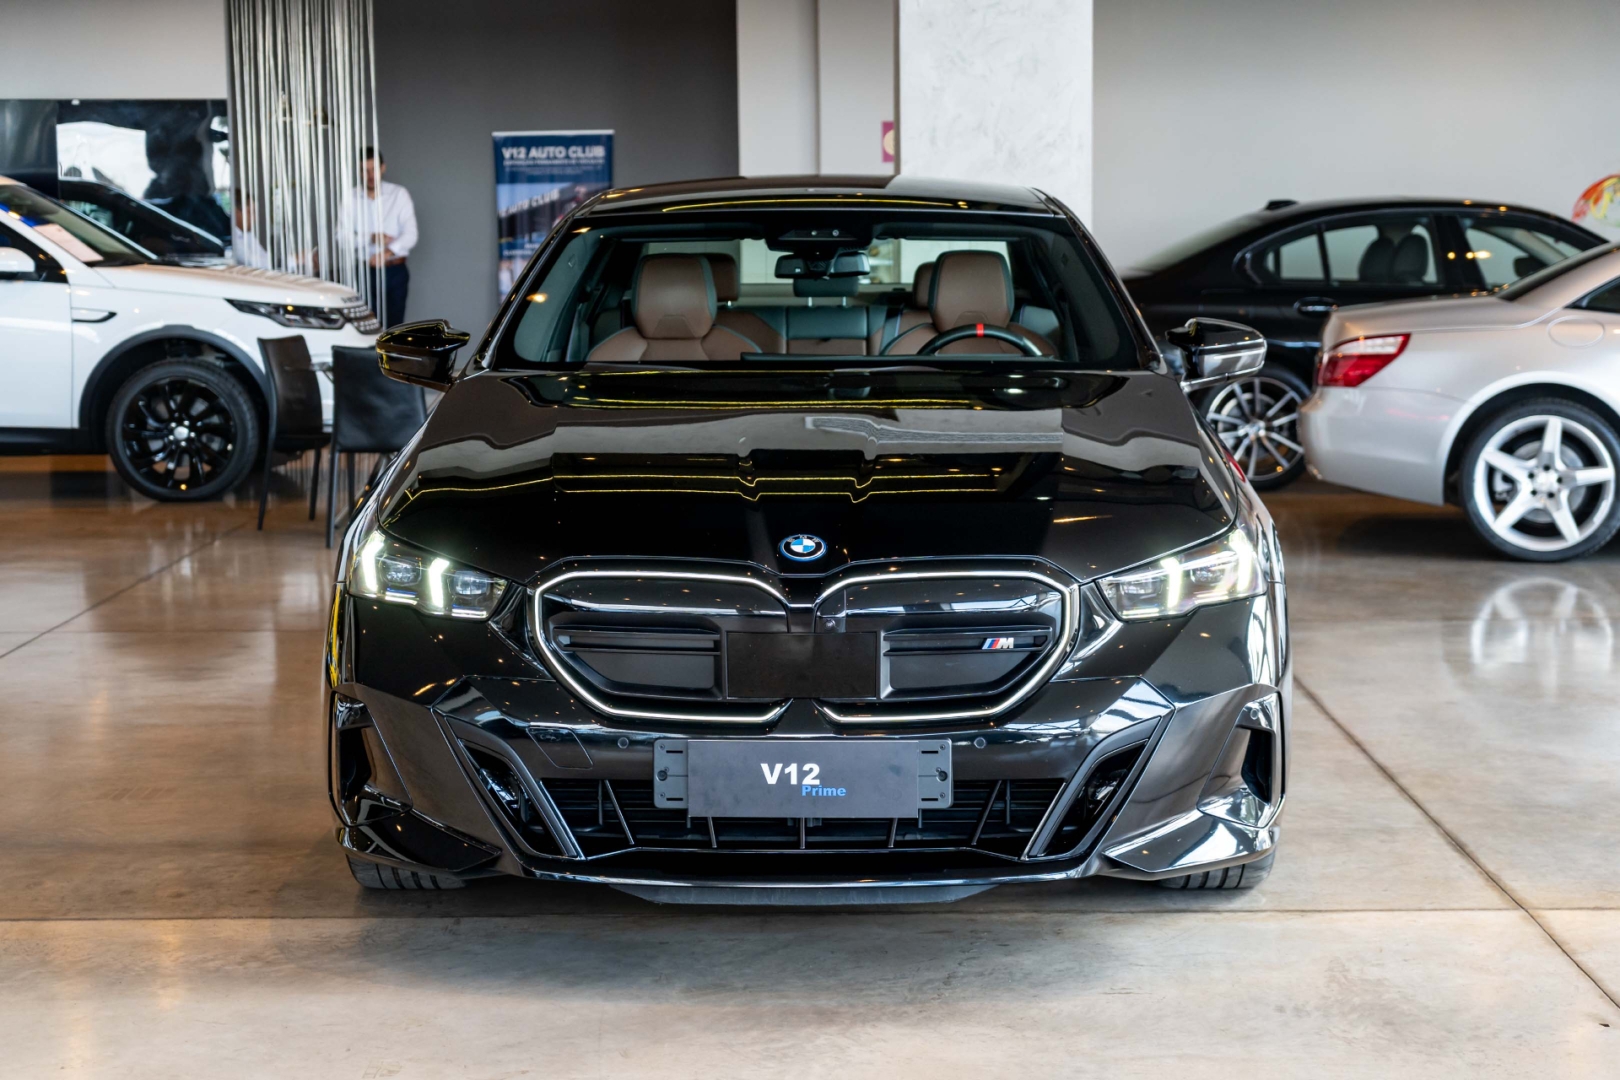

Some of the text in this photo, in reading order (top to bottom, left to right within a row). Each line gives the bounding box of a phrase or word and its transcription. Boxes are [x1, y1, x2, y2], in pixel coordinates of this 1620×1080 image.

[502, 145, 605, 159] V12 AUTO CLUB
[531, 189, 560, 207] CLUB
[760, 763, 820, 785] V12
[801, 785, 846, 797] Prime
